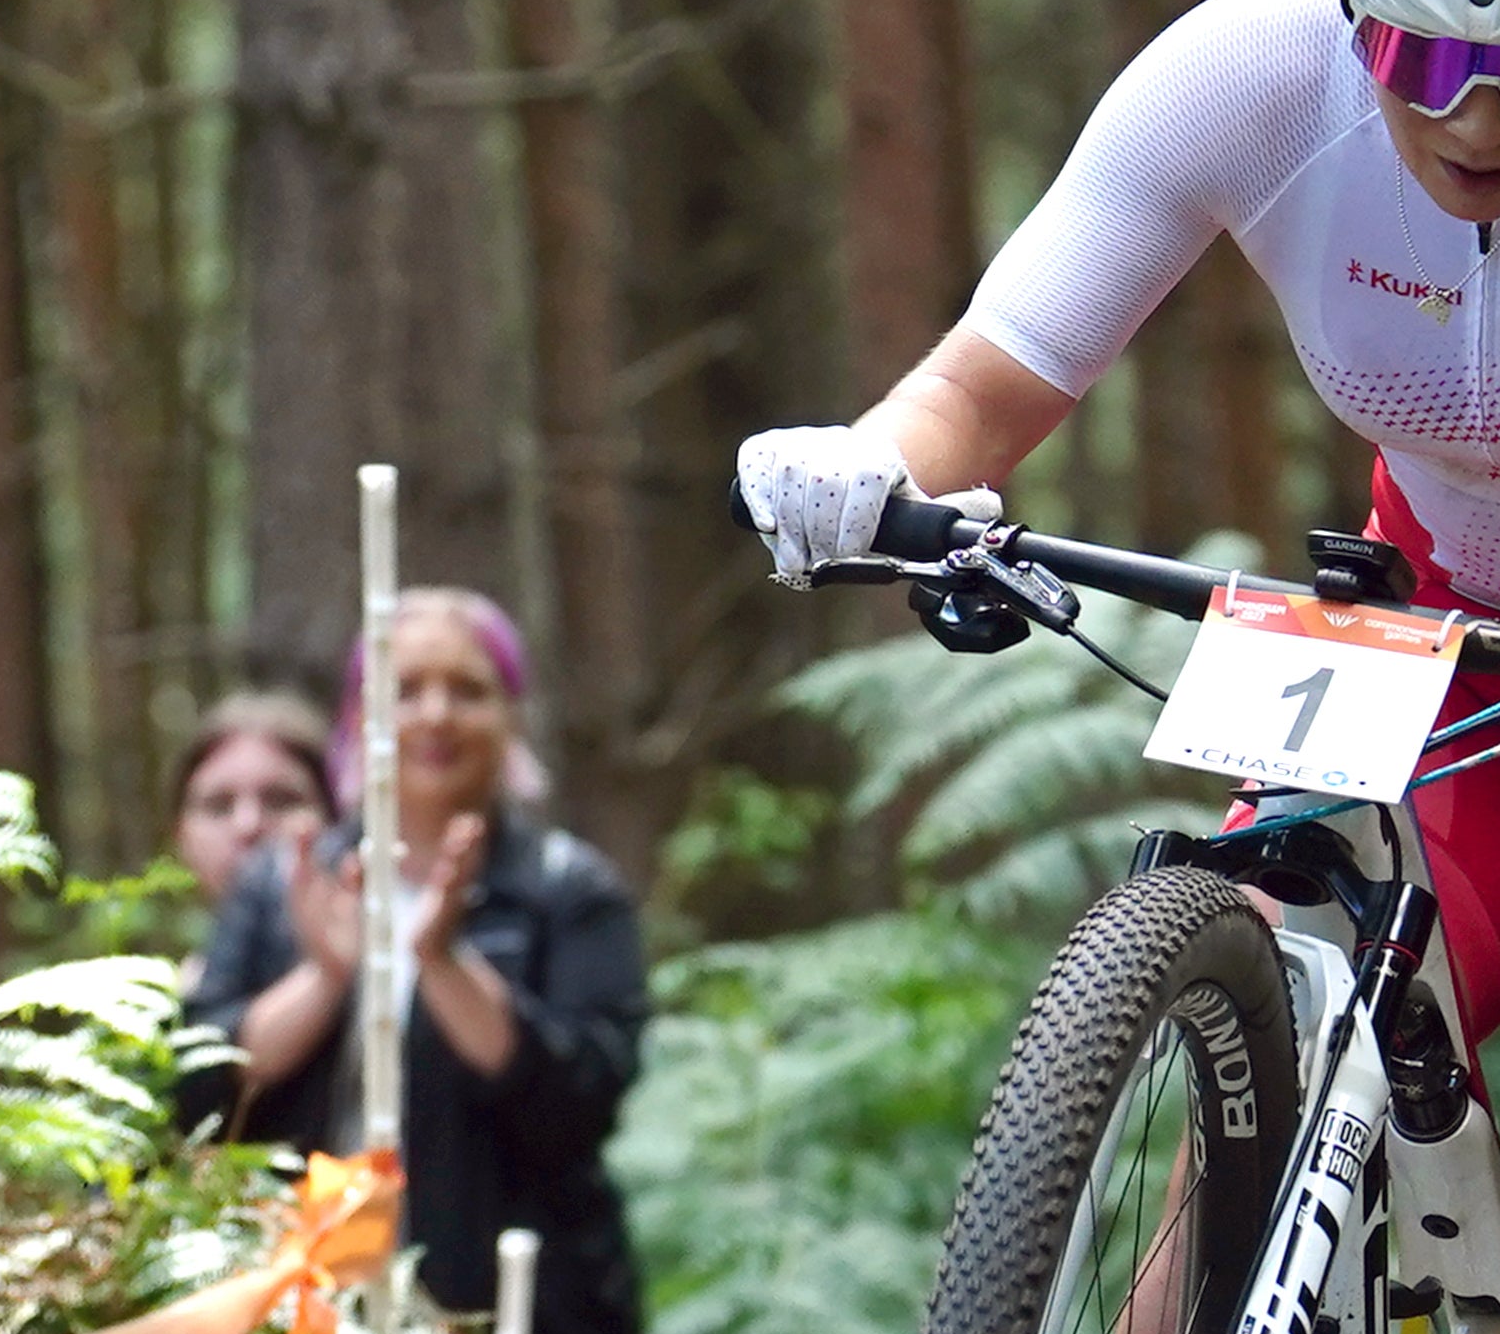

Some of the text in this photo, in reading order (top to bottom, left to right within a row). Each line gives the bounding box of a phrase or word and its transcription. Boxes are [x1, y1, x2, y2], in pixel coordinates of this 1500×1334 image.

[1324, 539, 1374, 556] GARMIN
[1384, 630, 1422, 645] games
[1281, 667, 1335, 753] 1
[1201, 748, 1314, 780] CHASE
